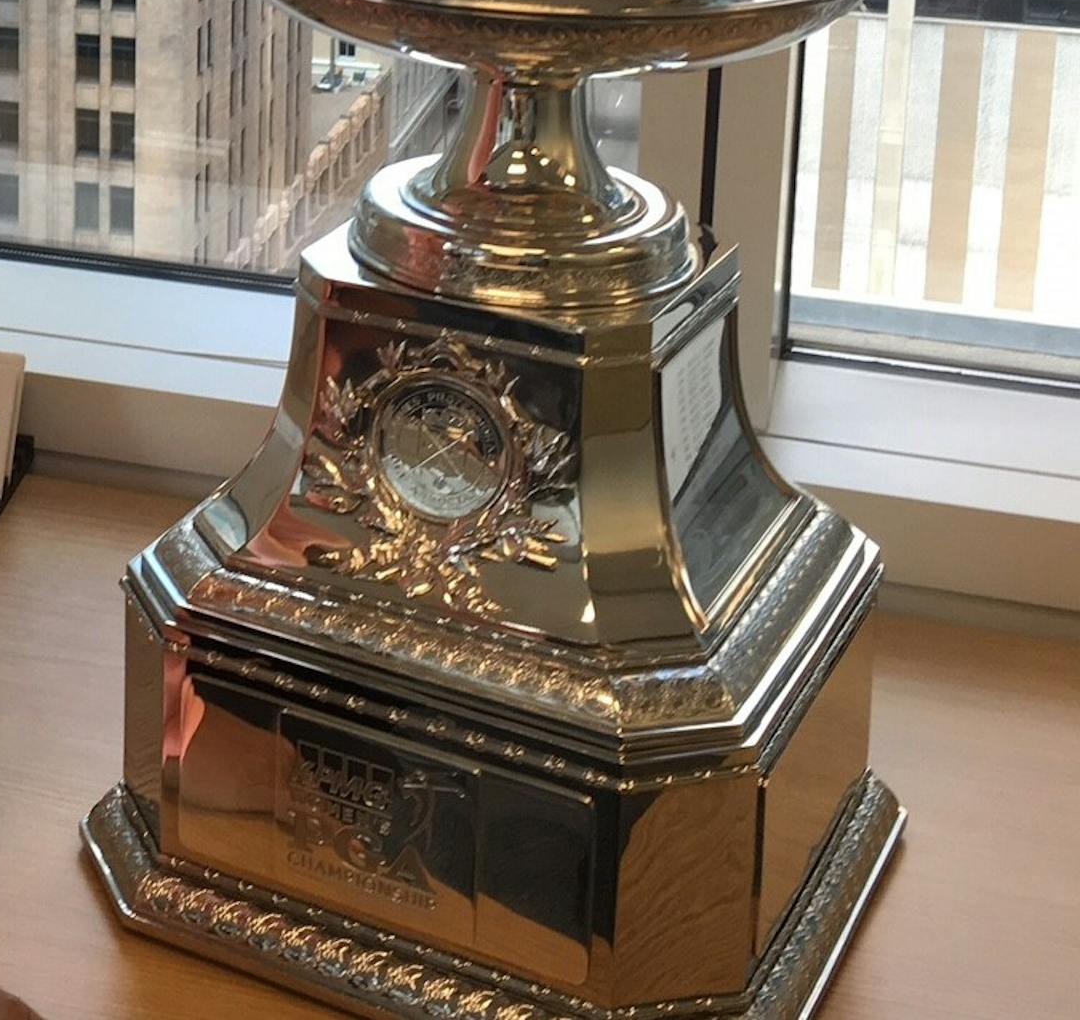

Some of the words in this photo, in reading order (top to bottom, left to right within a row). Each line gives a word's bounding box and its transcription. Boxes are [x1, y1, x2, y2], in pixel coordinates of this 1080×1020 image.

[292, 760, 391, 811] KPMG
[286, 850, 439, 912] CHAMPIONSHIP
[287, 809, 439, 895] PGA
